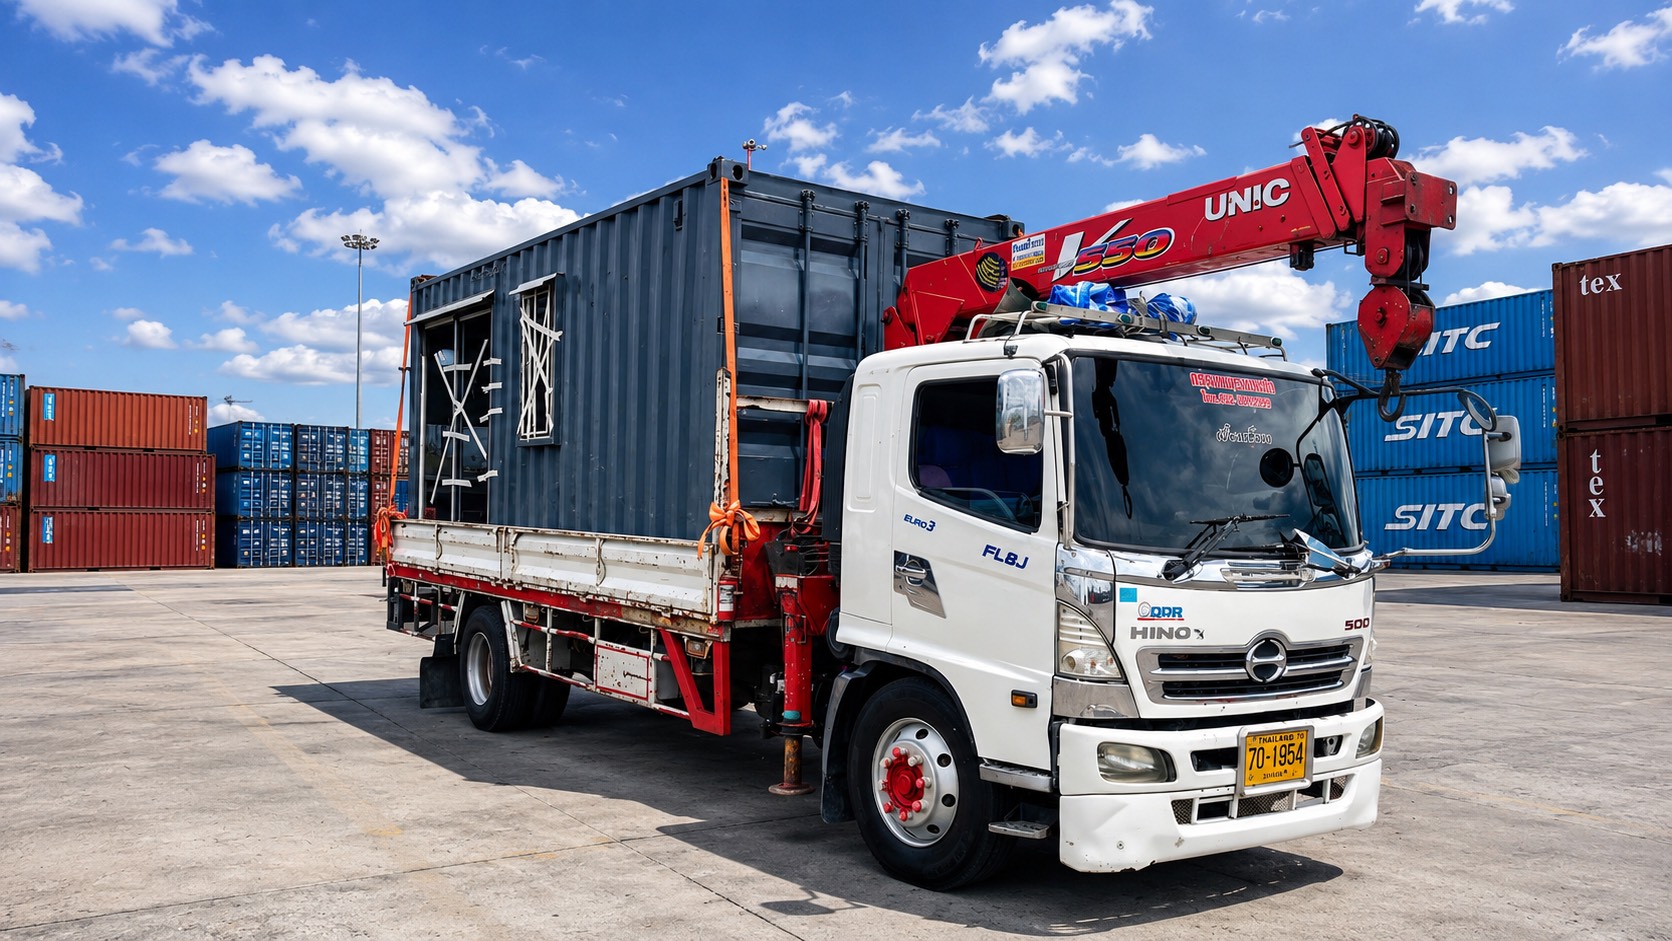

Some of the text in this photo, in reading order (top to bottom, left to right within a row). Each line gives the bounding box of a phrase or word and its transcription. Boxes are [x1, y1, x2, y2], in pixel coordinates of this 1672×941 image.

[1205, 177, 1290, 221] UNIC
[1579, 273, 1622, 297] tex
[1417, 321, 1501, 357] ITC
[1589, 448, 1606, 518] tex
[1384, 502, 1488, 531] SITC
[982, 544, 1029, 570] FL8J
[1130, 626, 1191, 640] HINO
[1345, 617, 1370, 631] 500
[1248, 741, 1304, 771] 70-1954
